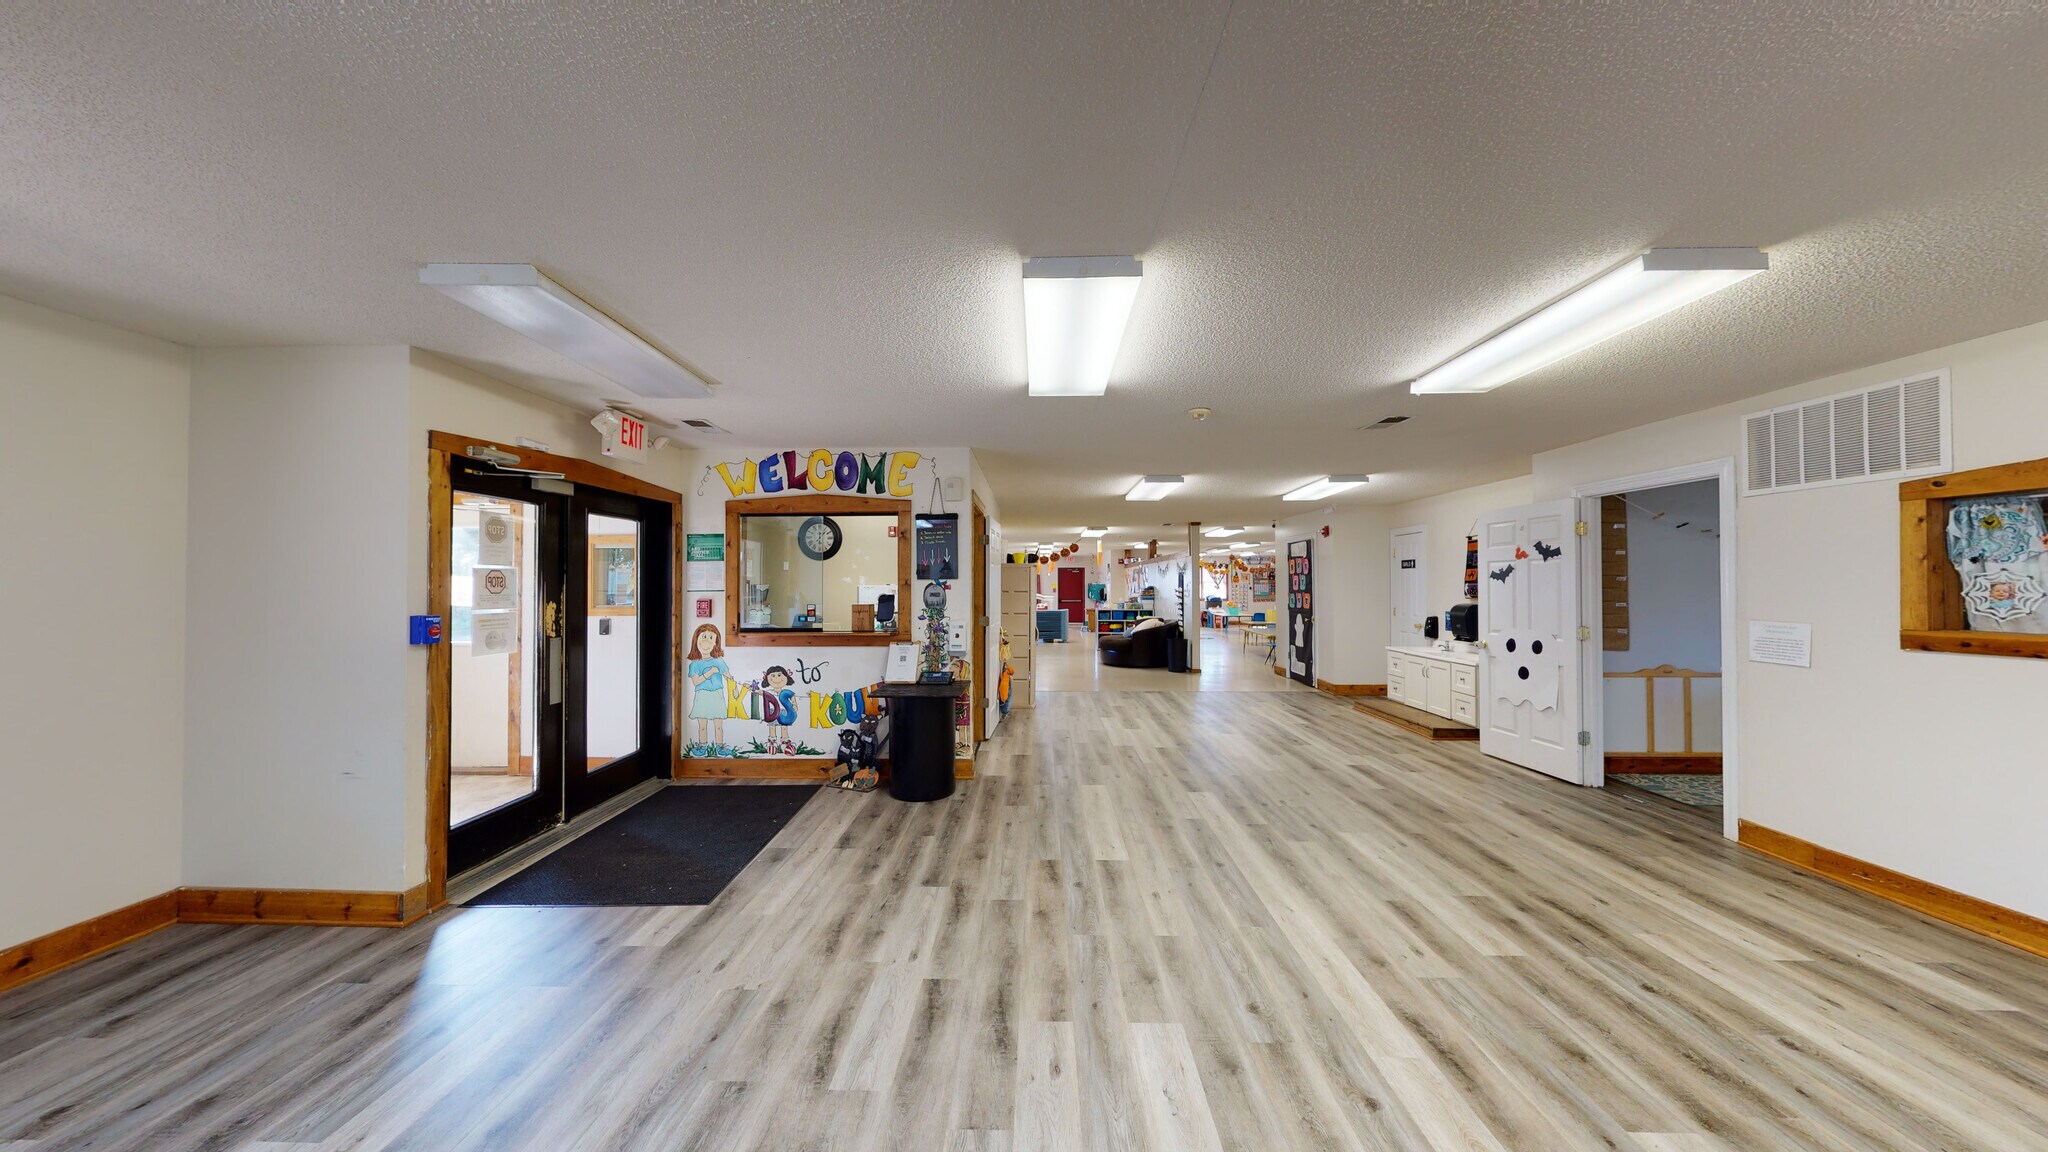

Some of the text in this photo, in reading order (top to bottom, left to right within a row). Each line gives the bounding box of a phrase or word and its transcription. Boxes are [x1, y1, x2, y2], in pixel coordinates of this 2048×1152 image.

[621, 416, 645, 450] EXIT
[714, 449, 921, 497] WELCOME
[697, 601, 708, 609] FIRE
[796, 658, 829, 685] to
[726, 677, 797, 726] KIDS
